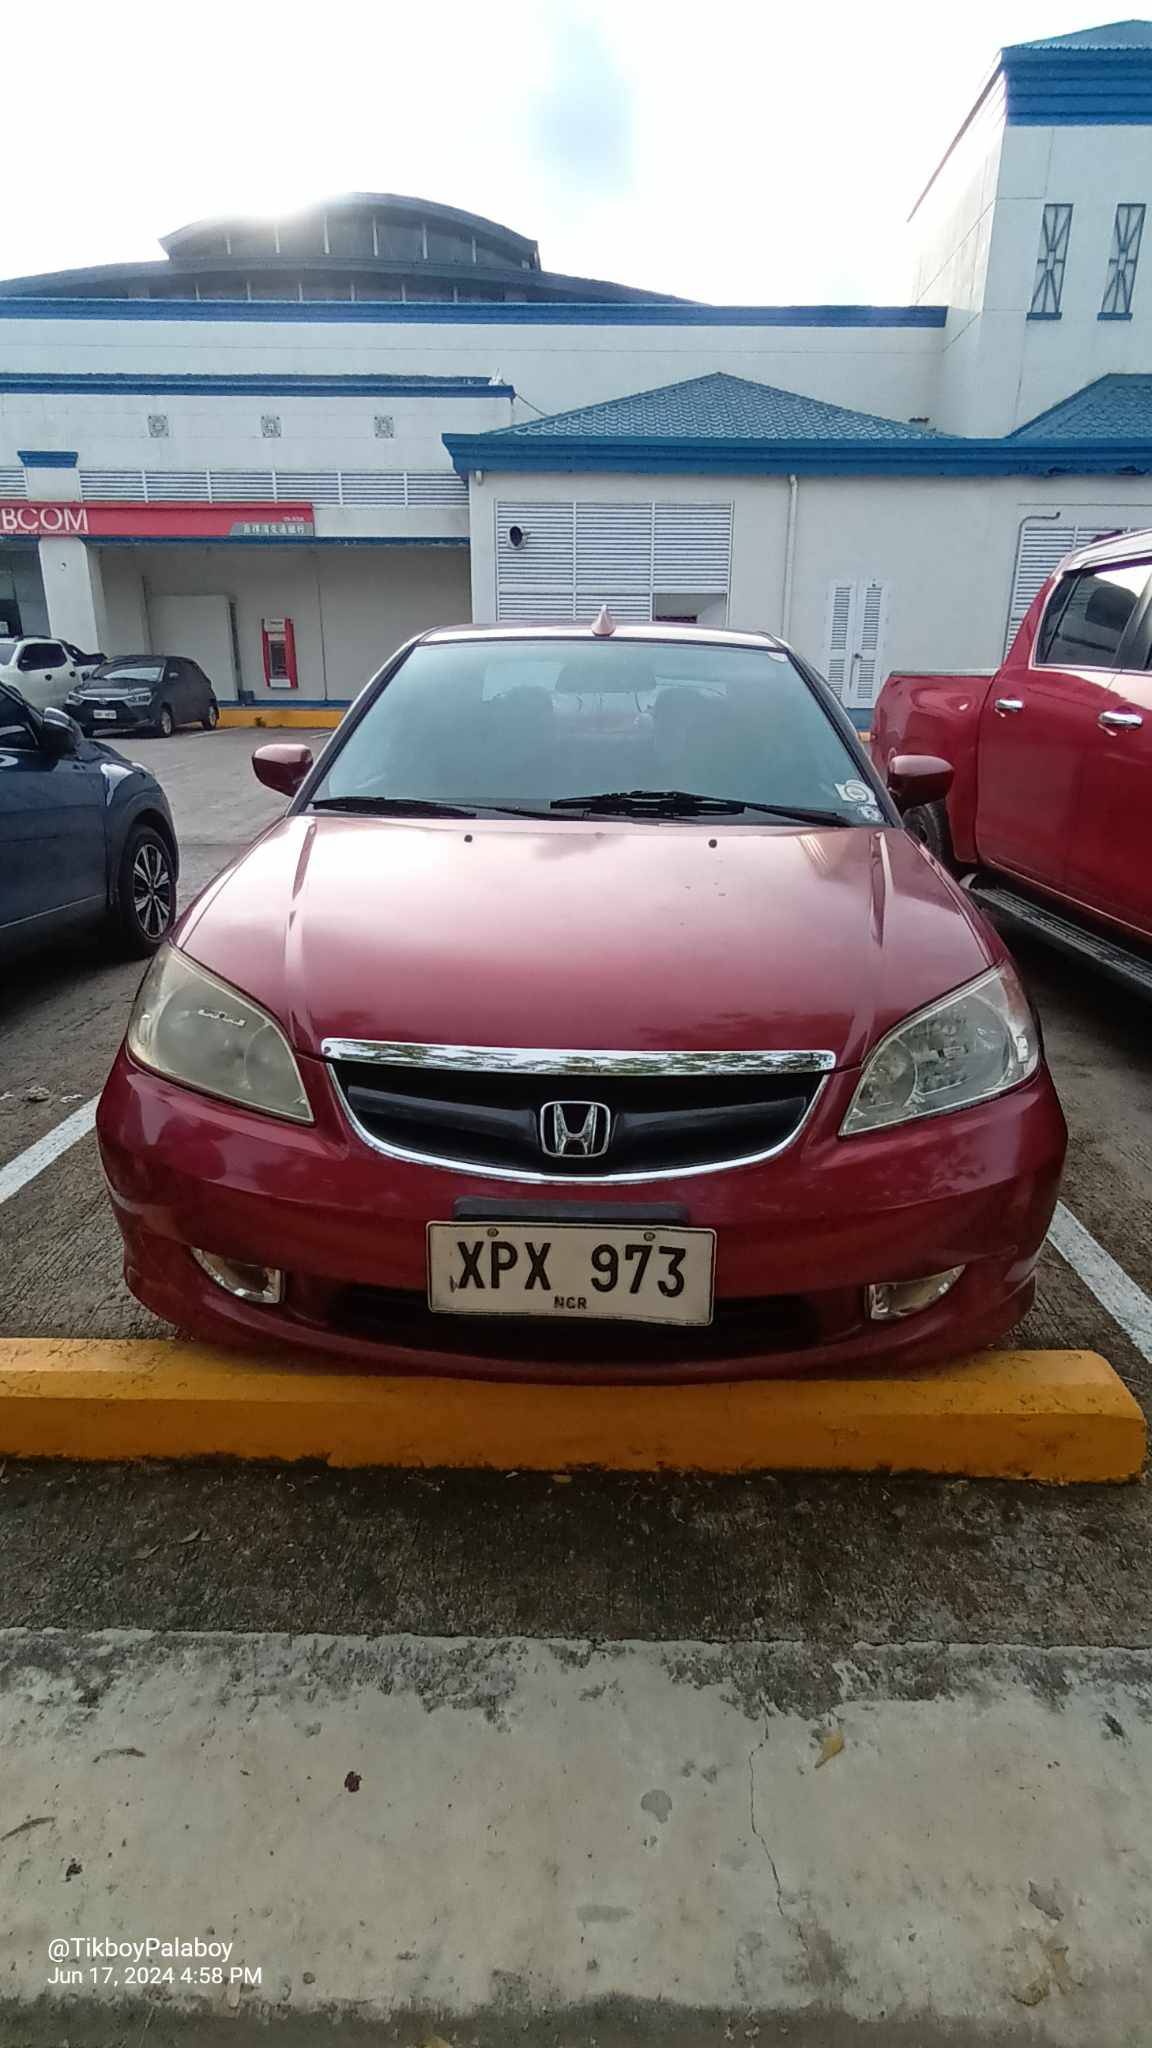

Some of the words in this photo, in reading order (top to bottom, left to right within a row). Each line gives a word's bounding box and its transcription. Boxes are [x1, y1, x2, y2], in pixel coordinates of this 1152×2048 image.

[457, 1241, 552, 1290] XPX
[591, 1244, 687, 1298] 973
[553, 1296, 588, 1310] NCR
